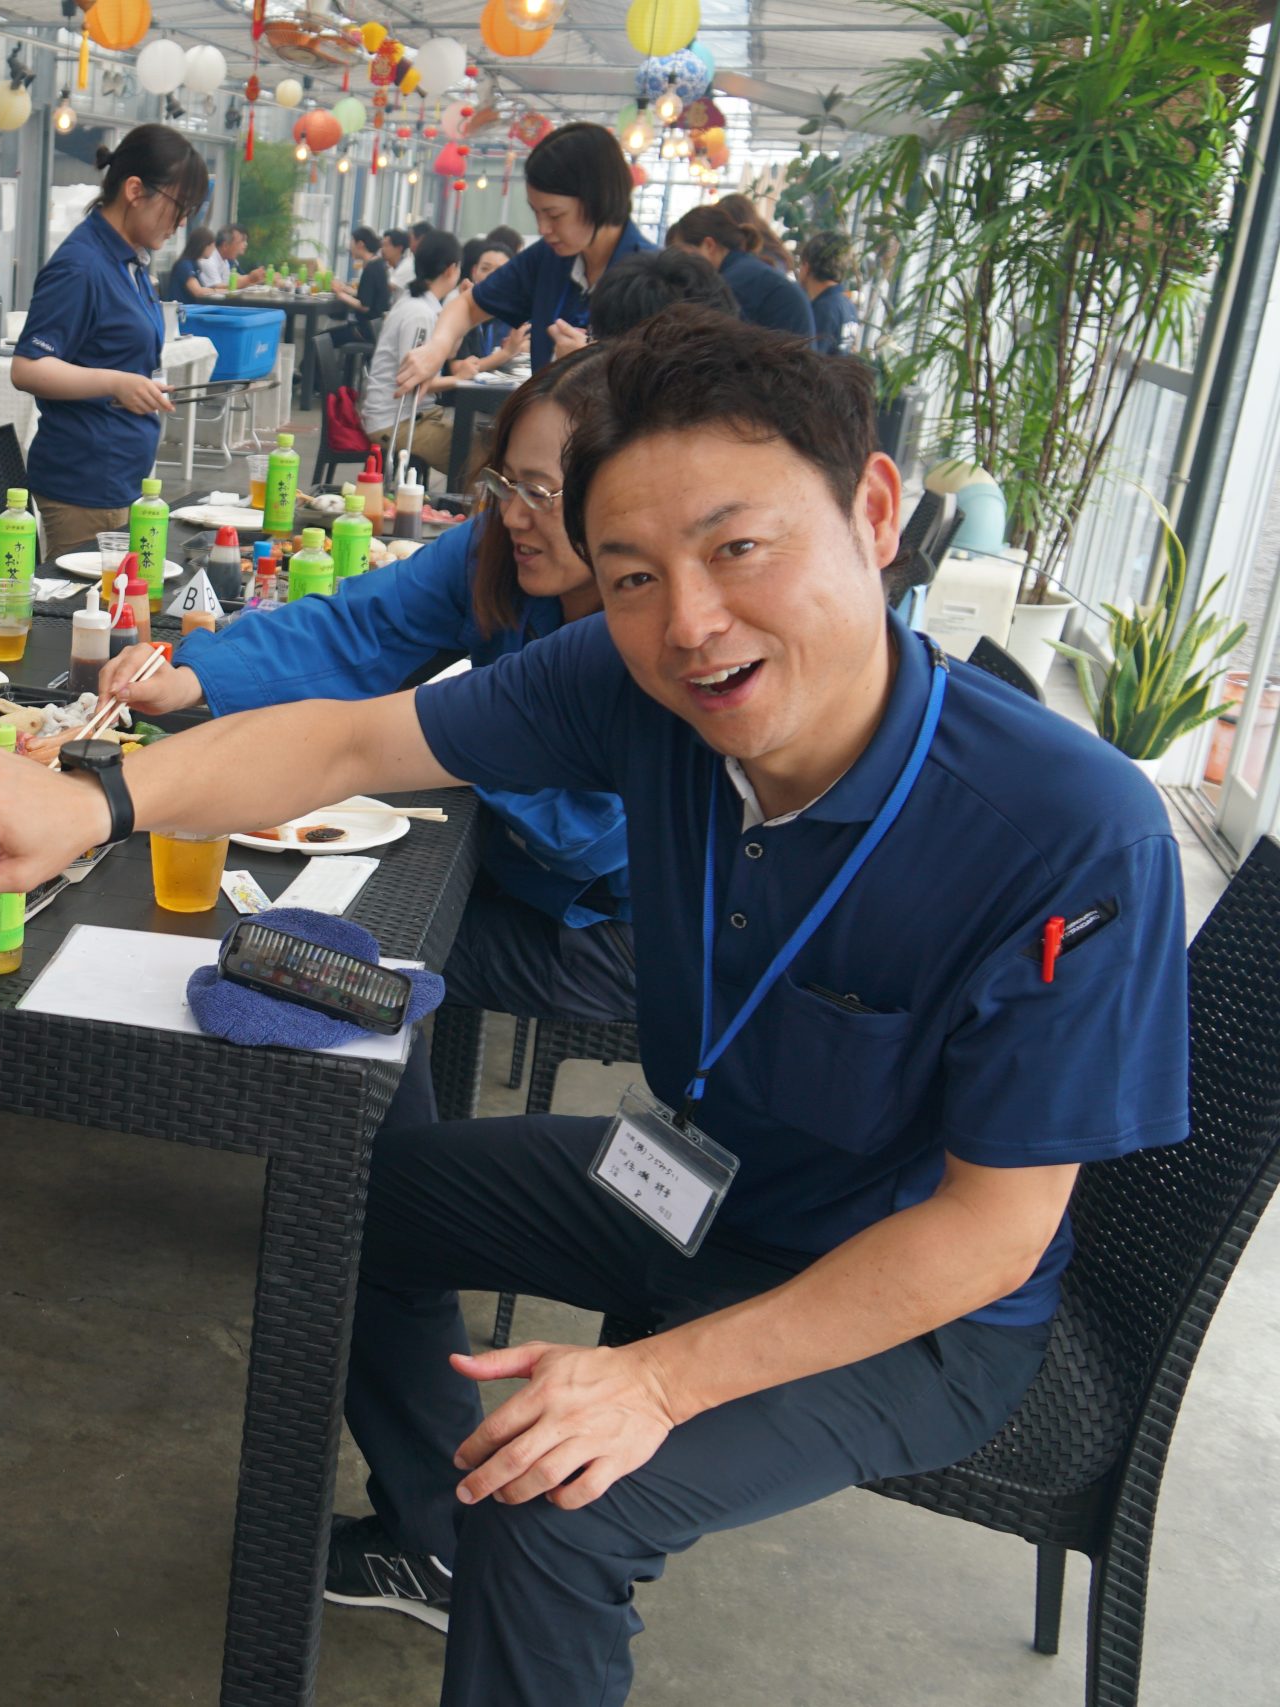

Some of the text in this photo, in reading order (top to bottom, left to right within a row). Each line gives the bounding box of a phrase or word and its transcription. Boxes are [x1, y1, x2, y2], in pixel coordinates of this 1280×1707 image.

[140, 536, 155, 569] お茶
[183, 587, 198, 610] B
[206, 587, 216, 611] B
[364, 1552, 428, 1601] N
